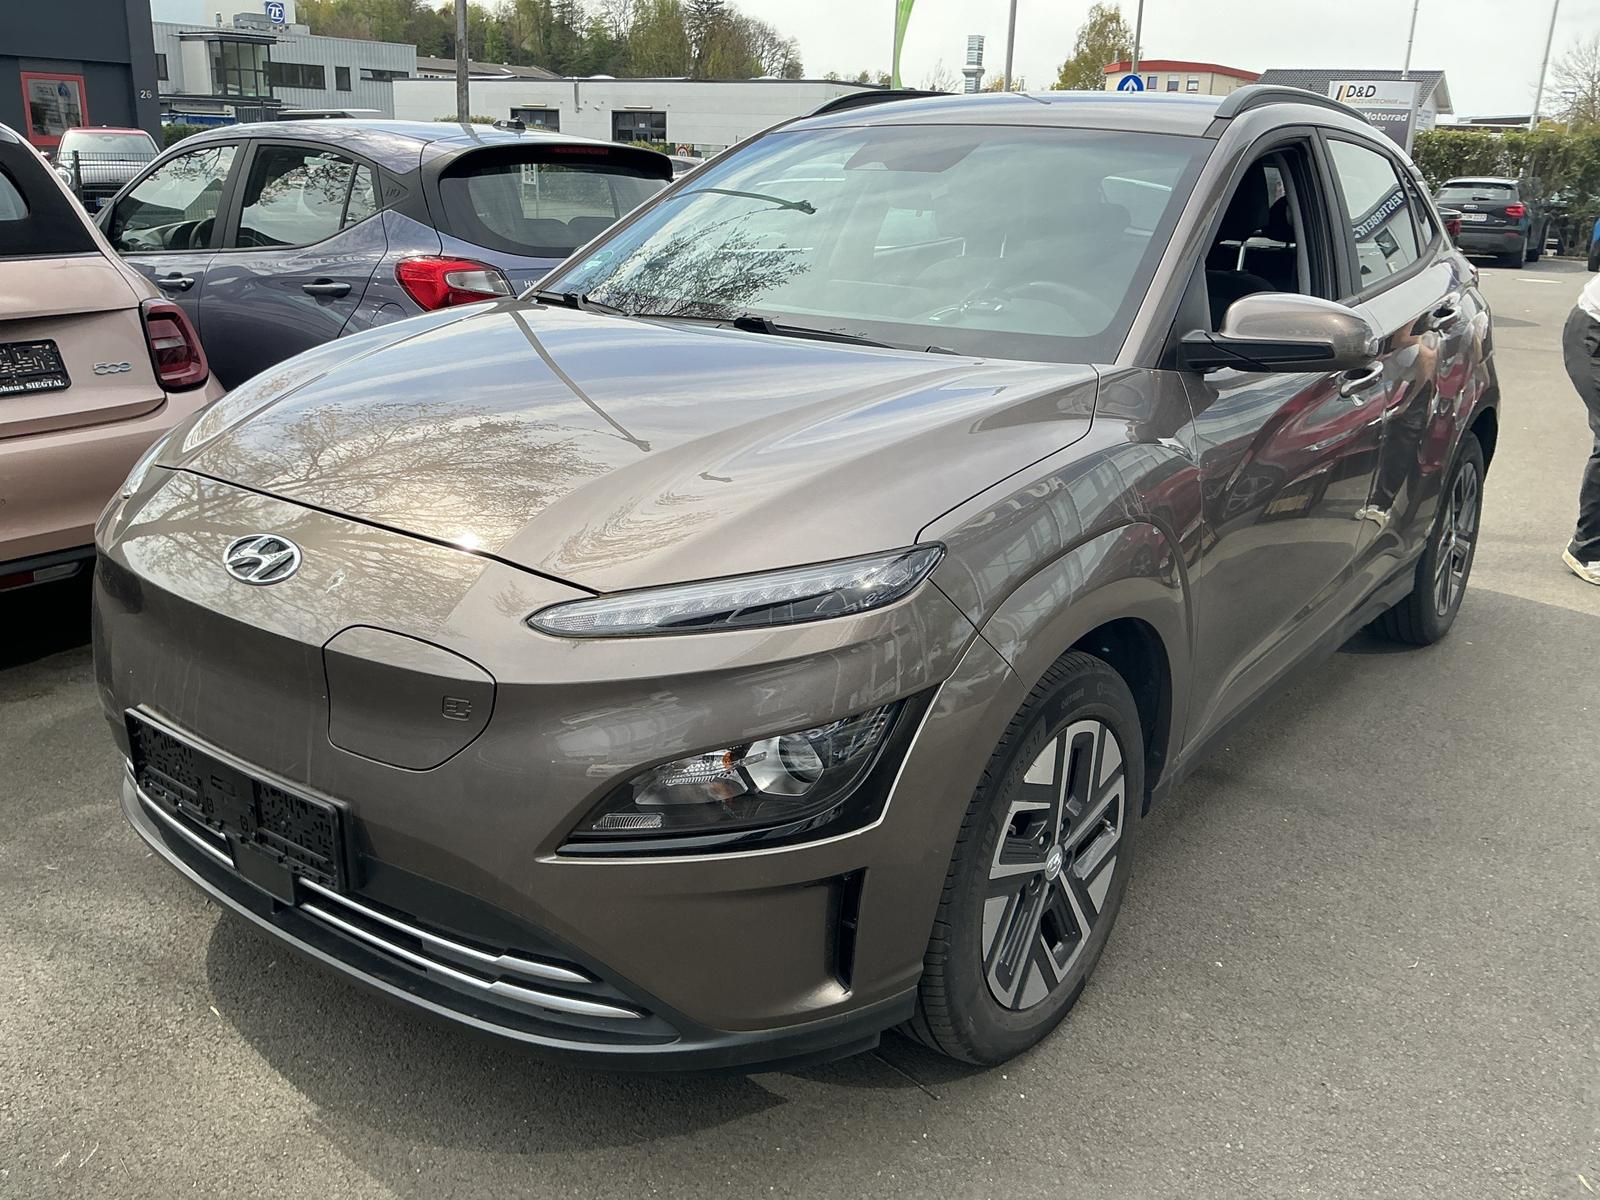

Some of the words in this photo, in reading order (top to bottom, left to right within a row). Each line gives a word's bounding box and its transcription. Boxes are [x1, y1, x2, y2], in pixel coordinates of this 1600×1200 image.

[140, 90, 152, 99] 26
[1346, 85, 1376, 98] D&D
[93, 361, 132, 376] 500
[25, 379, 65, 390] SIEGTAL
